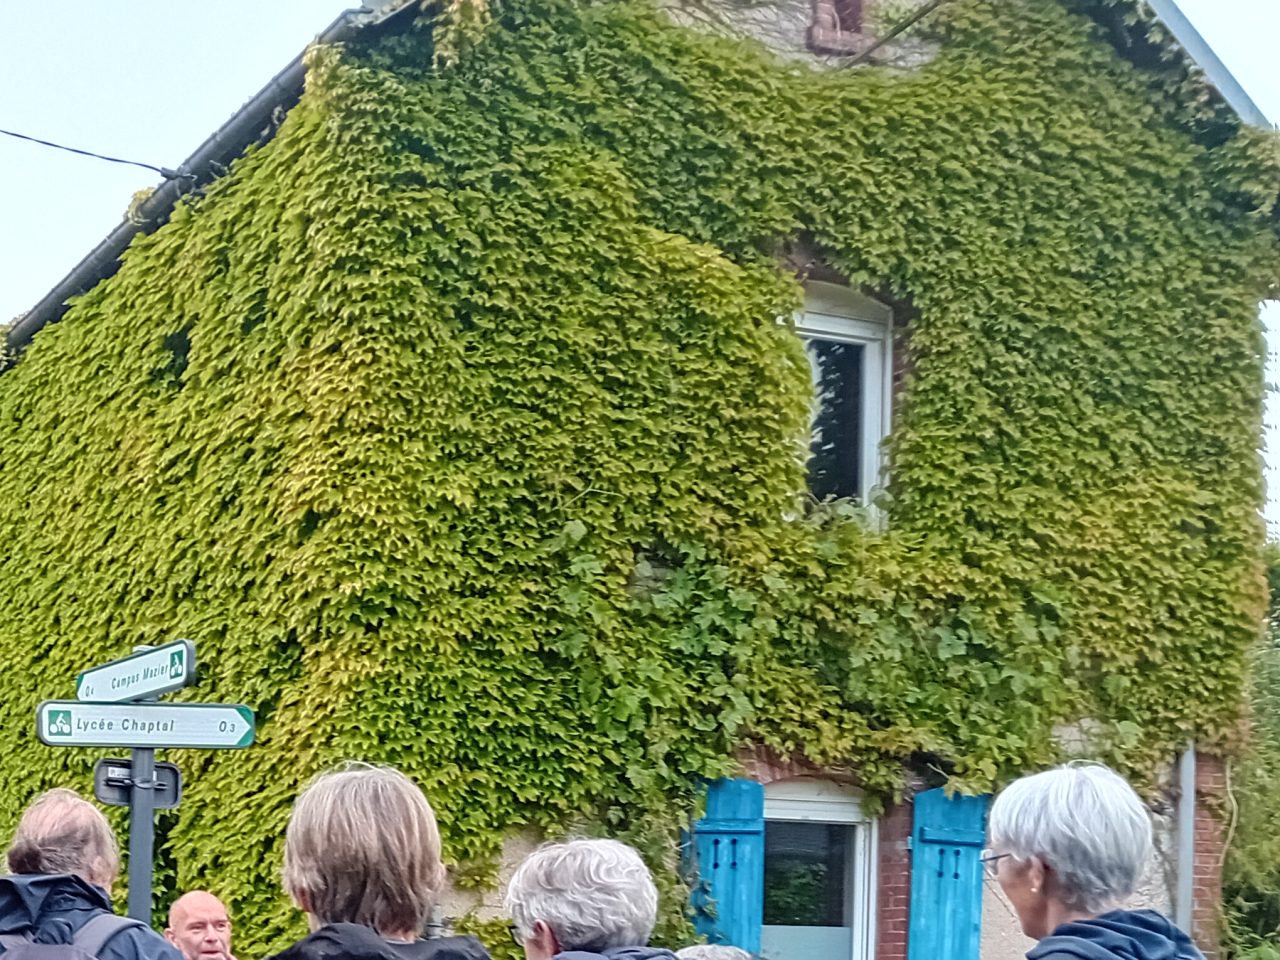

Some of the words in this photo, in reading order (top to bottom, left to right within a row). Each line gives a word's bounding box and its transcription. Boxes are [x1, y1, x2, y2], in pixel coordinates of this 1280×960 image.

[111, 672, 140, 690] Campus
[76, 718, 115, 732] Lycée
[121, 718, 175, 734] Chaptal
